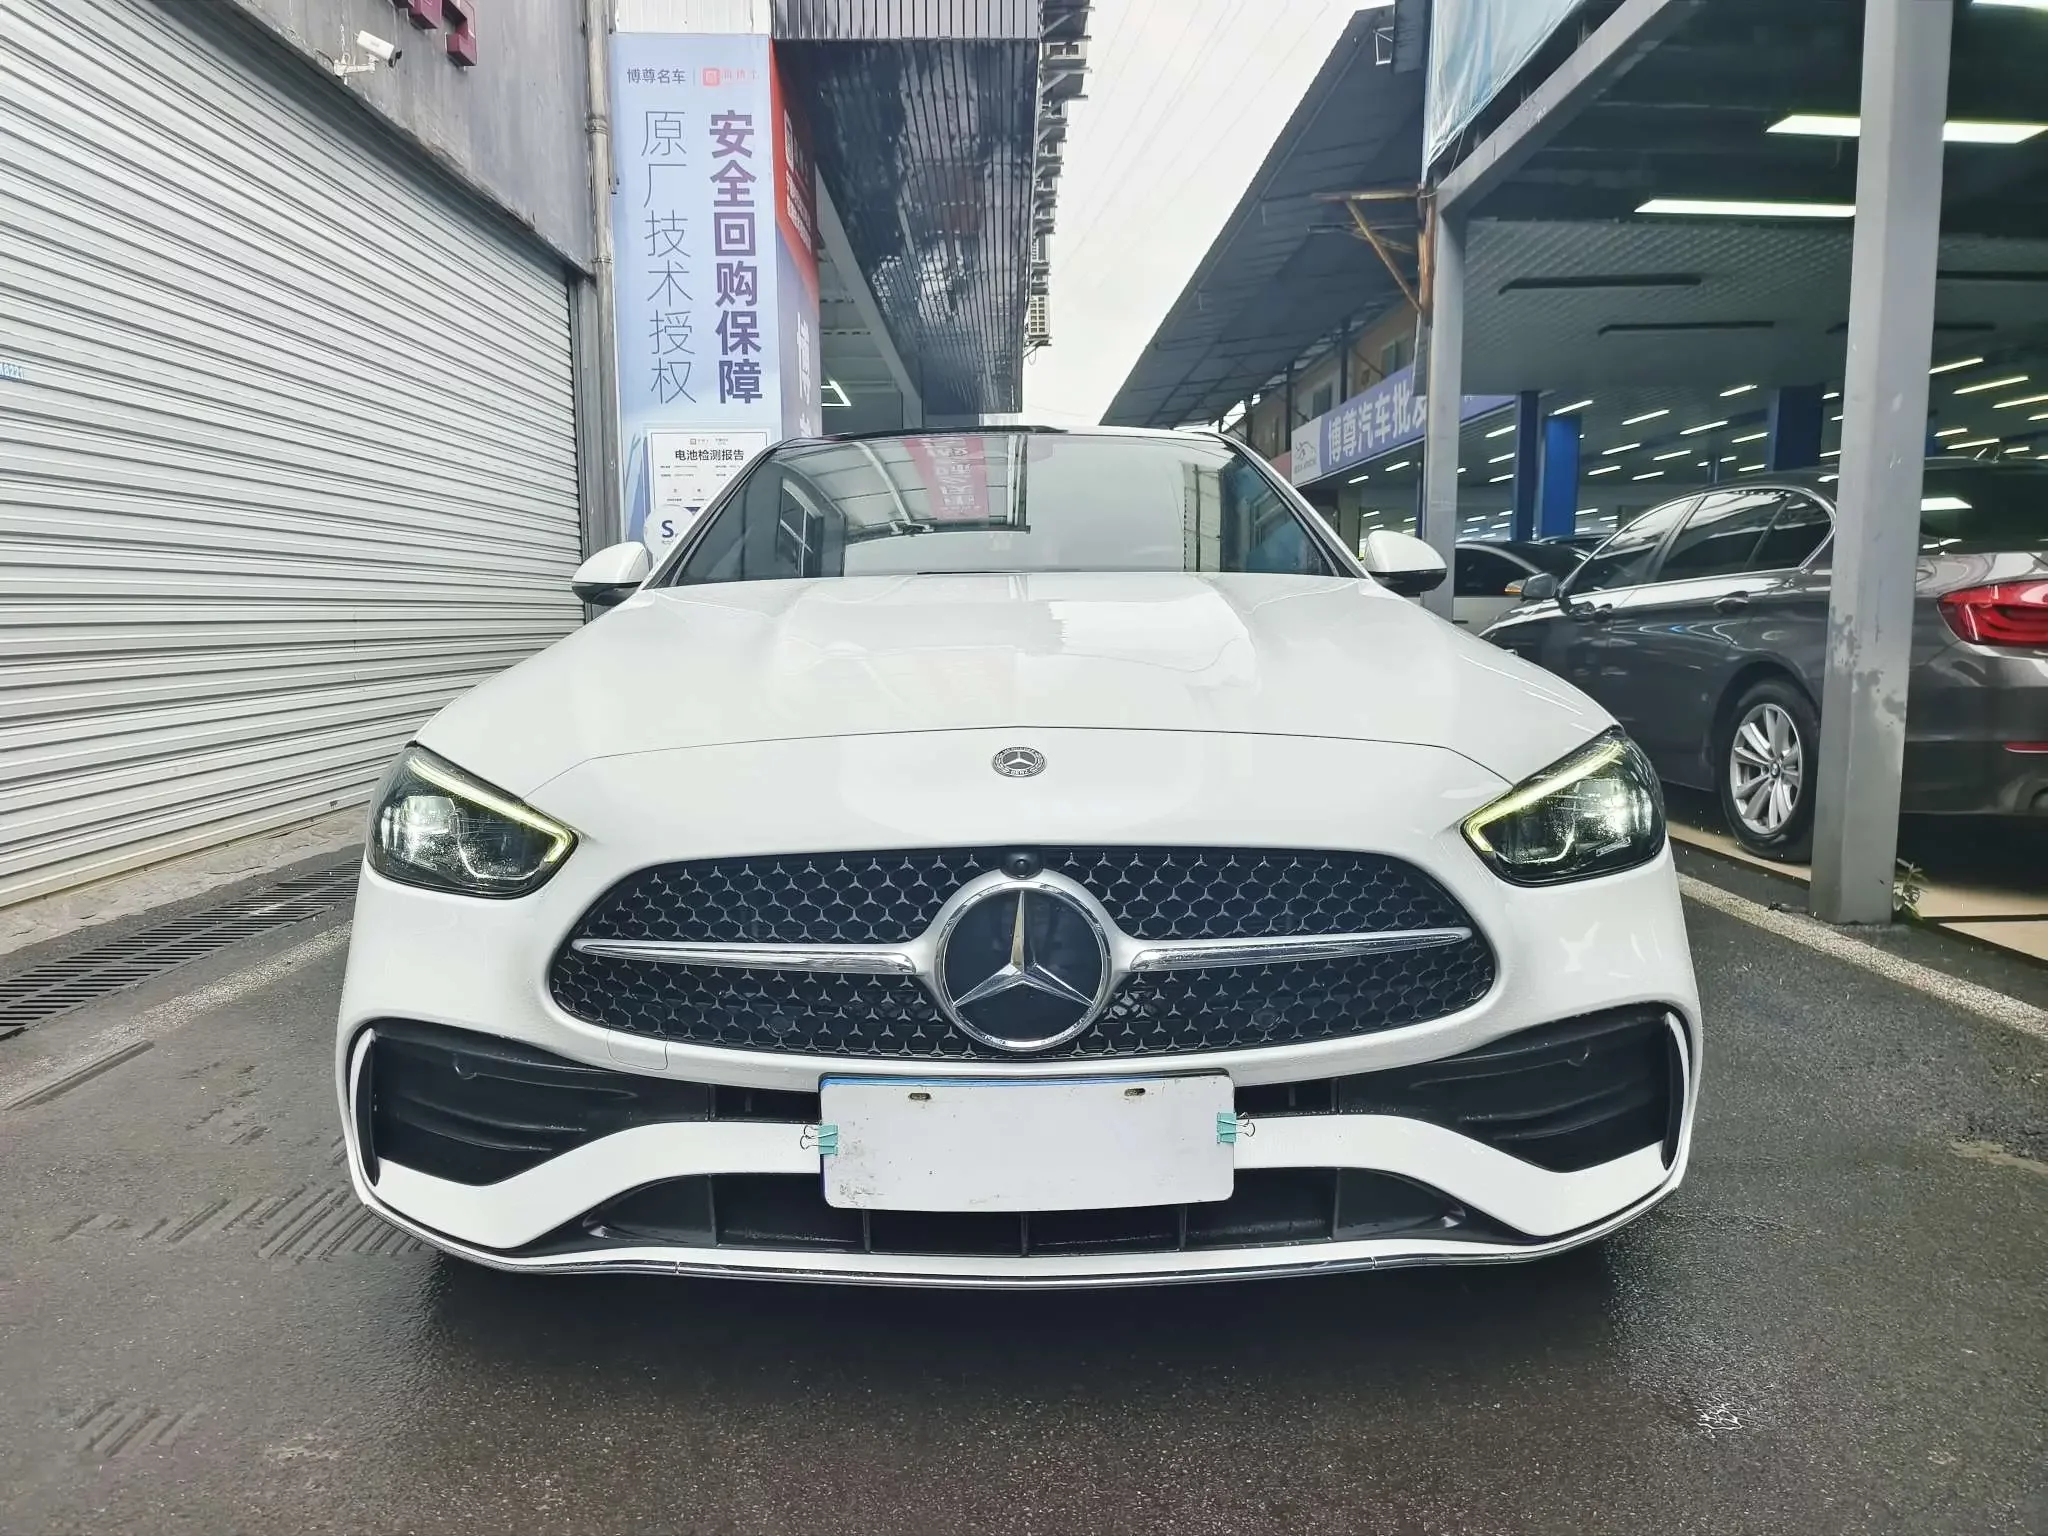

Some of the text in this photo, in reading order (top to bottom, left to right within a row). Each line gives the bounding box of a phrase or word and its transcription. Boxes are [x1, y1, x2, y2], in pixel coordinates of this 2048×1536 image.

[627, 67, 686, 84] 博尊名车
[641, 110, 697, 404] 原厂技术授权
[709, 109, 763, 404] 安全回购保障
[675, 449, 744, 461] 电池检测报告
